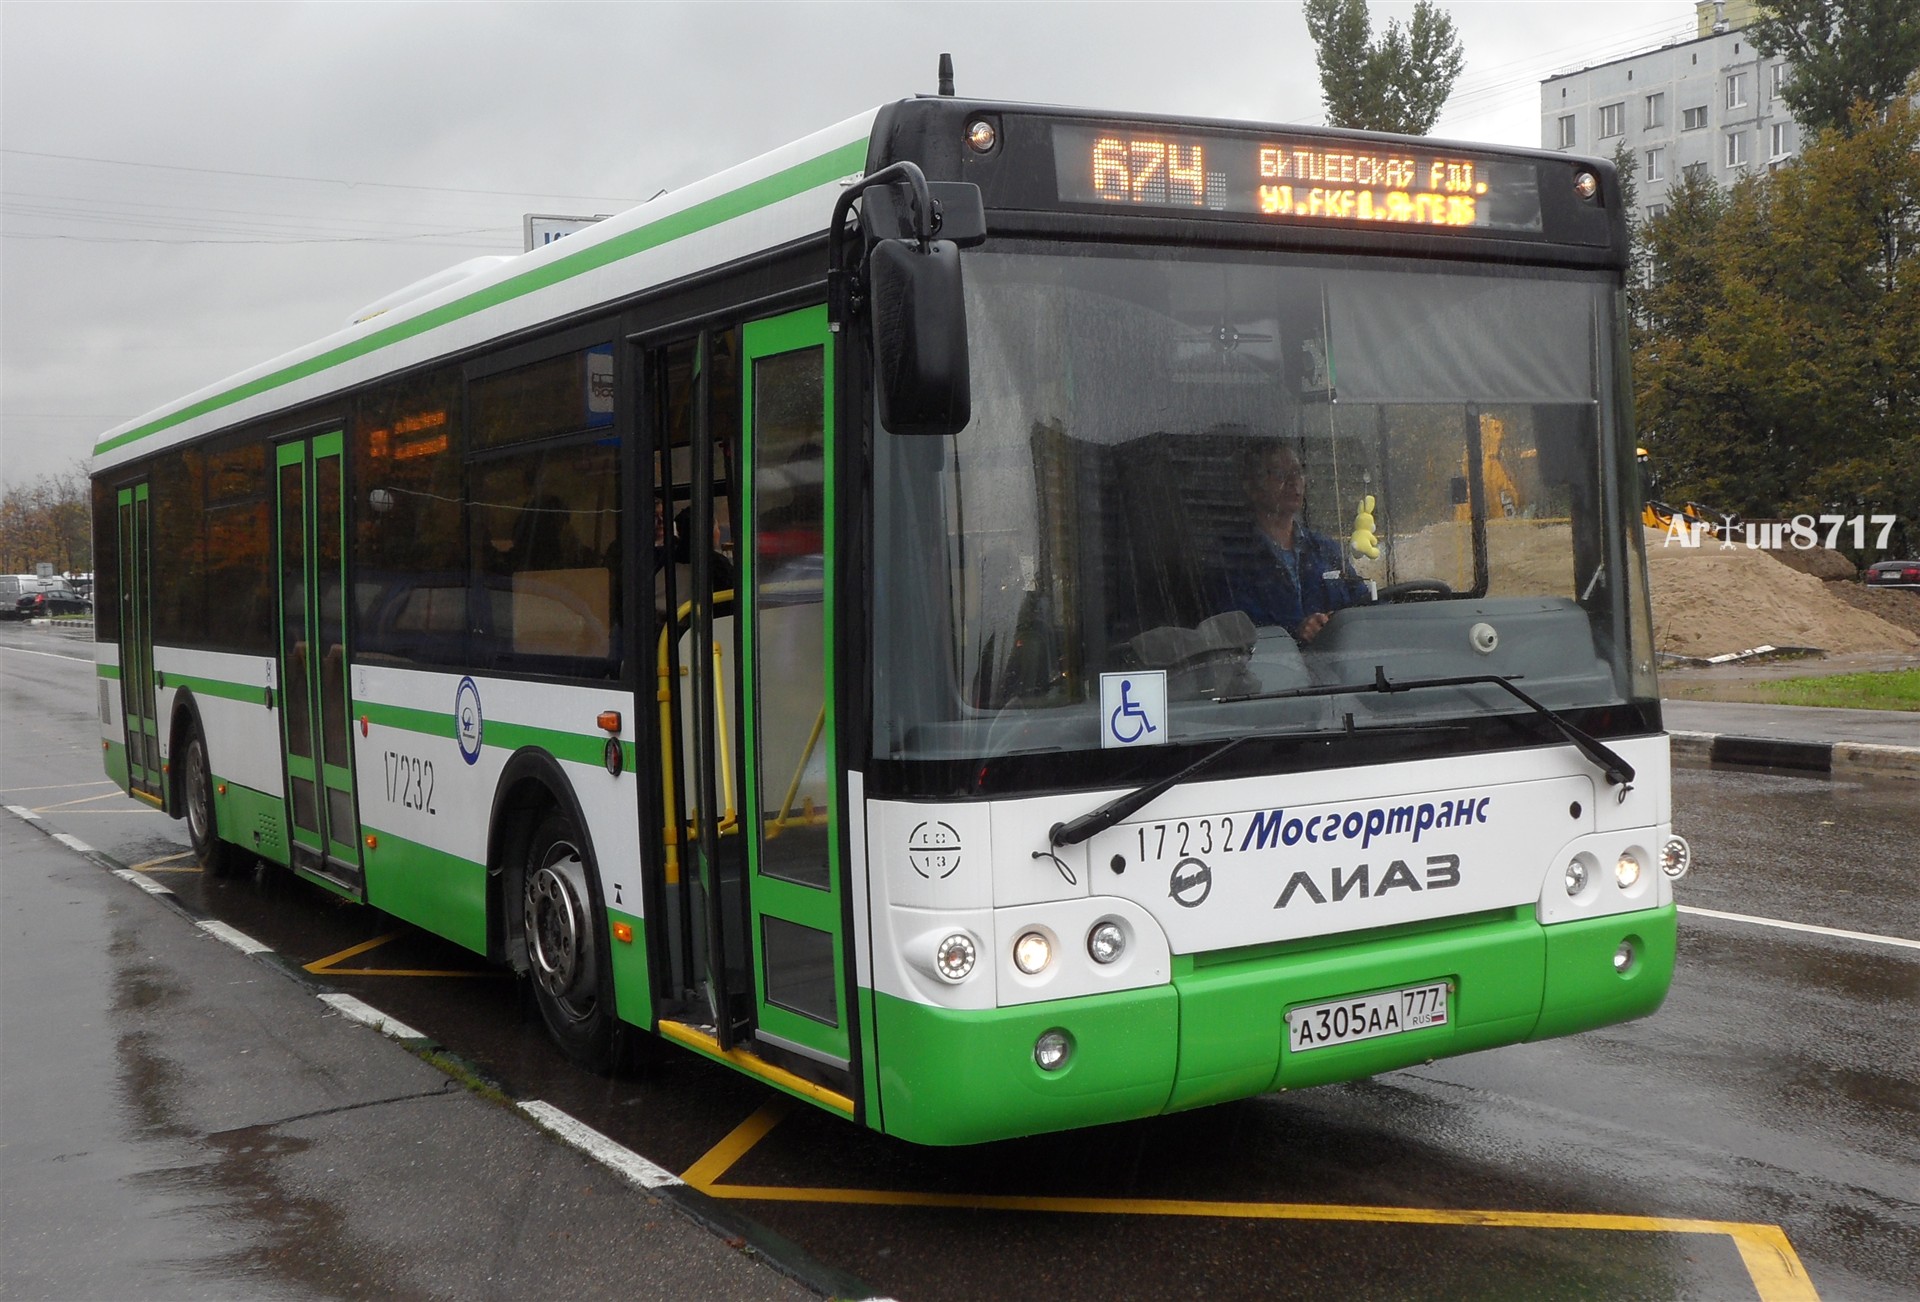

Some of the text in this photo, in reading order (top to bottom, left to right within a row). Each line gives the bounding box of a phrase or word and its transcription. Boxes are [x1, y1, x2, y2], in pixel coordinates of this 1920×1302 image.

[1093, 138, 1202, 205] 674
[384, 751, 436, 815] 17232
[1138, 817, 1234, 862] 17232
[1239, 797, 1490, 850] Мосгортранс
[1273, 854, 1461, 909] ЛИАЗ
[1404, 988, 1440, 1017] 777
[1412, 1013, 1431, 1025] RUS
